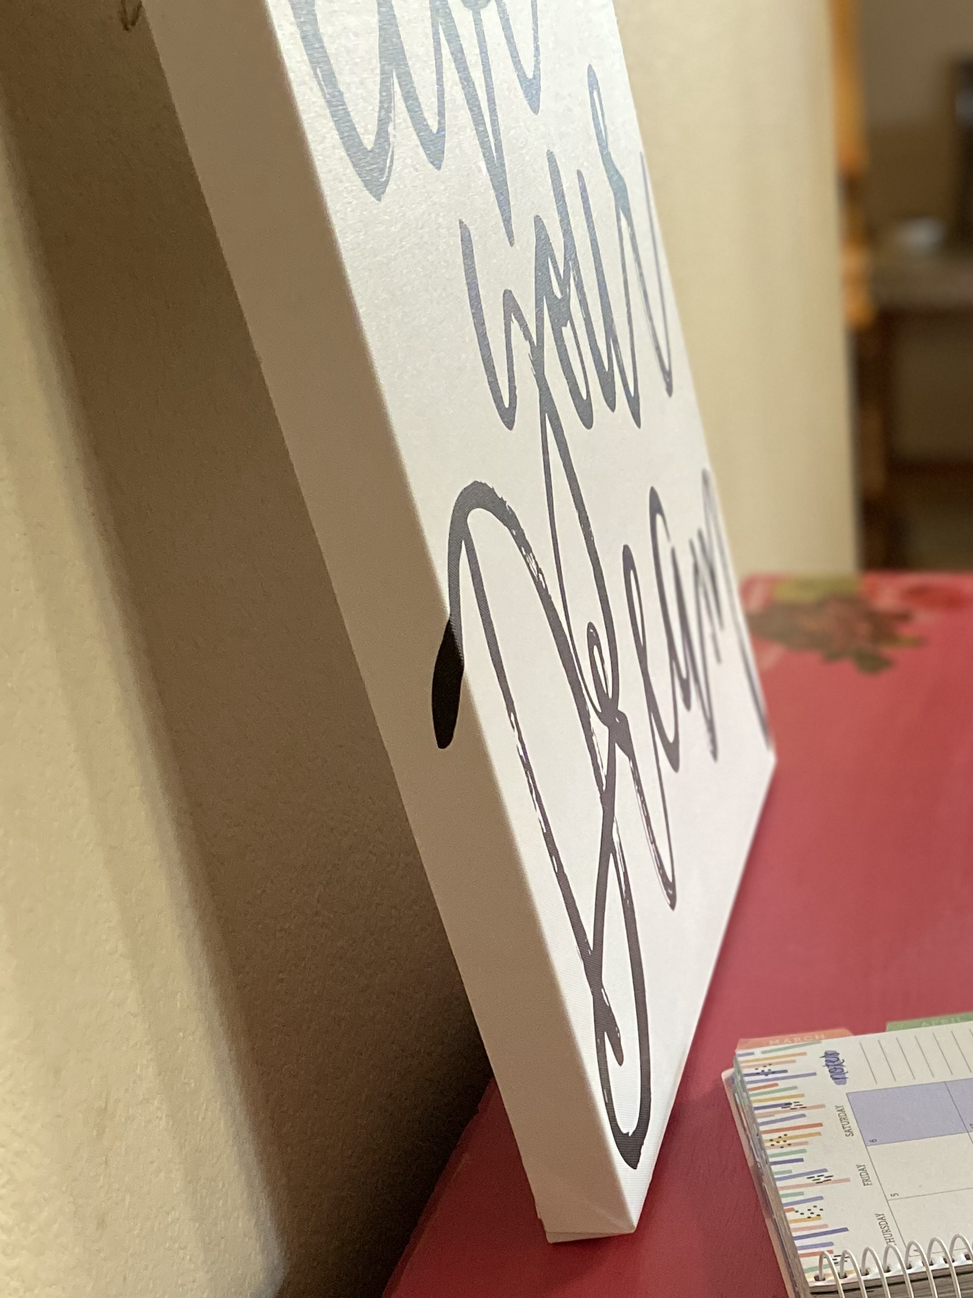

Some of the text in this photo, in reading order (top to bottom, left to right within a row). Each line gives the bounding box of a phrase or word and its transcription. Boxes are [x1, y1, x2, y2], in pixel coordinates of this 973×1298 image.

[457, 63, 673, 736] your
[430, 460, 772, 1169] Dream
[834, 1104, 855, 1138] SATURDAY
[856, 1163, 874, 1187] FRIDAY
